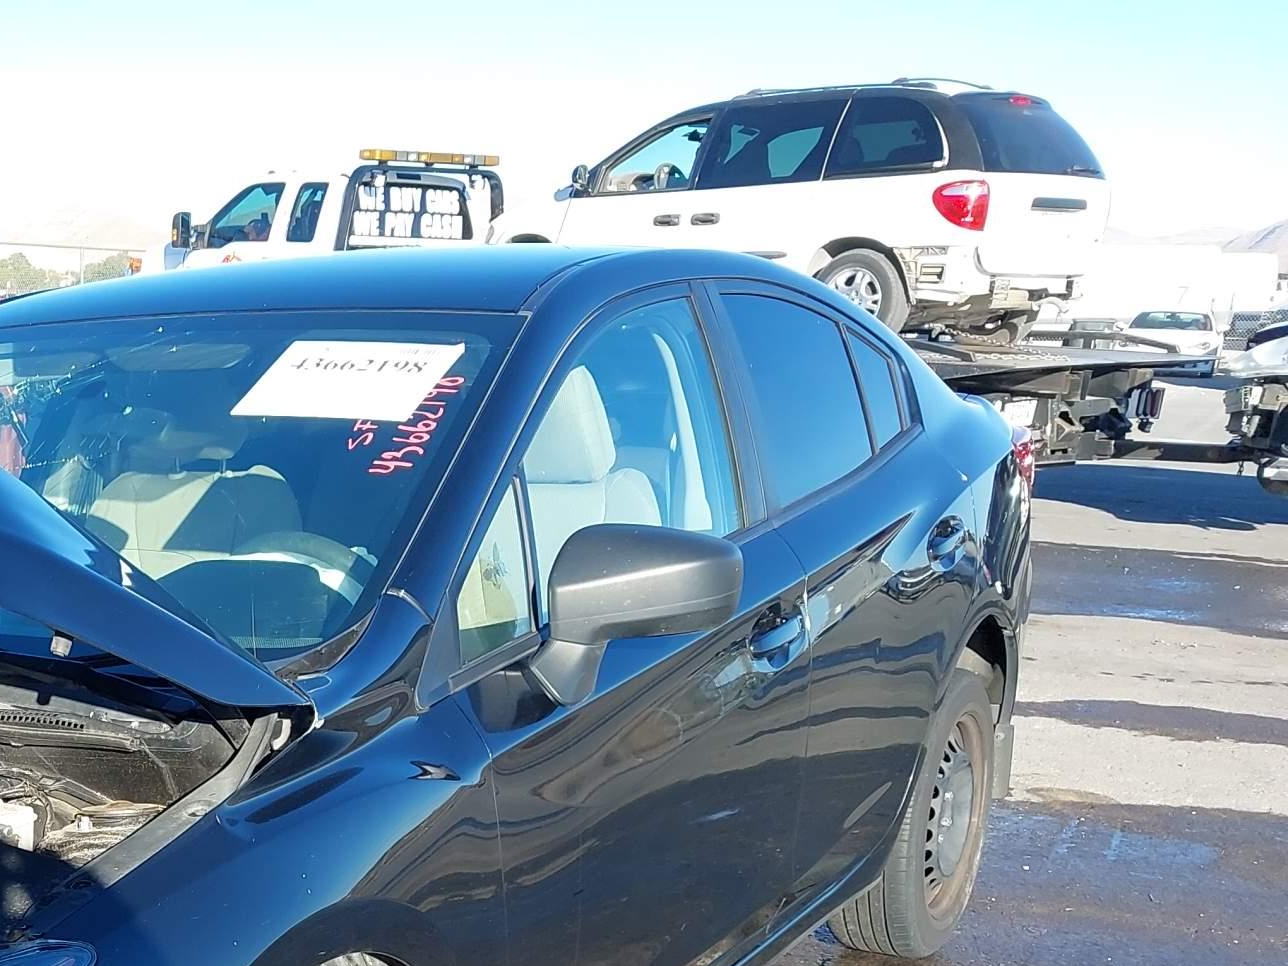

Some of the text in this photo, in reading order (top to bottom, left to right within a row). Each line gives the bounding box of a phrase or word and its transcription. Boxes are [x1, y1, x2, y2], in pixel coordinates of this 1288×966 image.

[389, 186, 422, 212] BUY
[353, 210, 463, 240] WE PAY CASH
